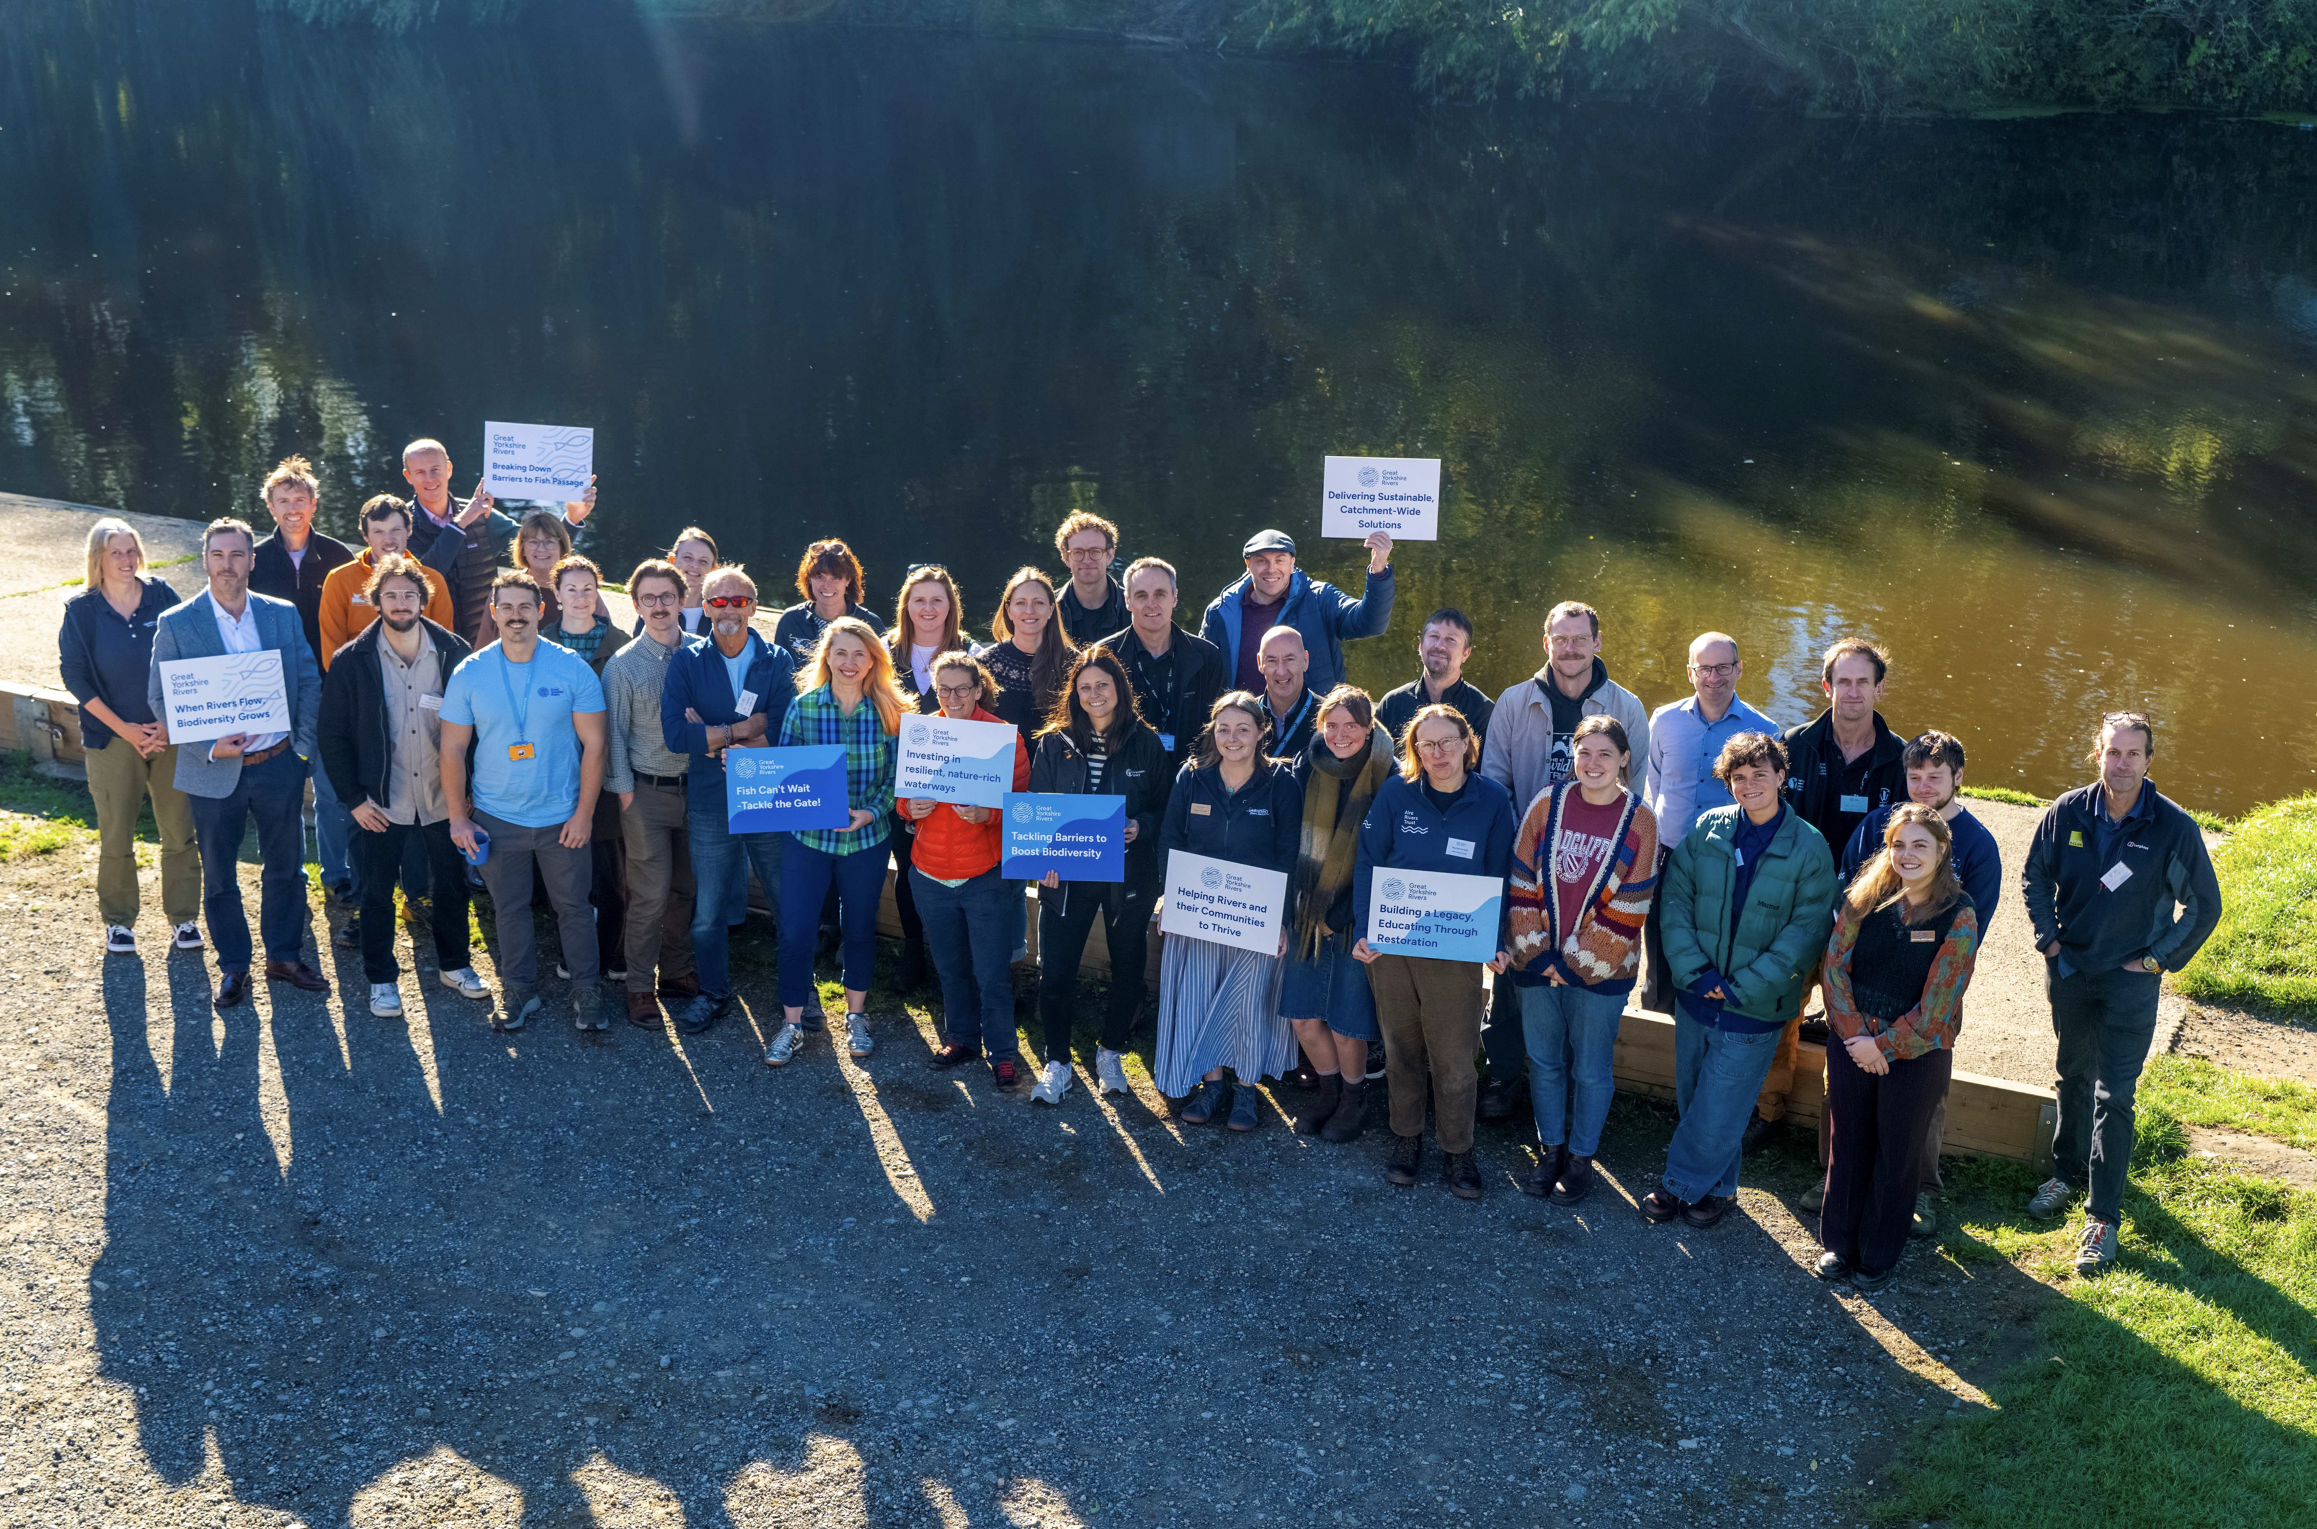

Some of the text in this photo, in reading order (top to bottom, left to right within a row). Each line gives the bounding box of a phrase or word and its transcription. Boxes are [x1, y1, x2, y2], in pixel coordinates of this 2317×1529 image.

[493, 434, 514, 442] Great
[493, 441, 526, 449] Yorkshire
[492, 462, 527, 472] Breaking
[492, 474, 522, 482] Barriers
[552, 478, 584, 487] Passage
[1328, 491, 1434, 503] Delivering Sustainable,
[1340, 506, 1421, 515] Catchment-Wide
[1358, 520, 1402, 529] Solutions
[170, 673, 194, 681] Great
[172, 679, 209, 688] Yorkshire
[173, 688, 198, 696] Rivers
[175, 698, 266, 713] When Rivers Flow,
[177, 711, 270, 727] Biodiversity Grows
[907, 750, 960, 764] Investing in
[905, 766, 1001, 782] resilient, nature-rich
[736, 784, 810, 795] Fish Can't Wait
[904, 780, 956, 793] waterways
[737, 798, 821, 810] -Tackle the Gate!
[1011, 832, 1107, 843] Tackling Barriers to
[1012, 847, 1102, 860] Boost Biodiversity
[1226, 873, 1242, 882] Great
[1225, 884, 1242, 892] Rivers
[1226, 879, 1251, 889] Yorkshire
[1178, 887, 1267, 913] Helping Rivers and
[1176, 901, 1265, 928] their Communities
[1380, 904, 1421, 918] Building
[1434, 909, 1474, 922] Legacy,
[1199, 921, 1241, 937] to Thrive
[1378, 919, 1478, 937] Educating Through
[1377, 934, 1438, 947] Restoration
